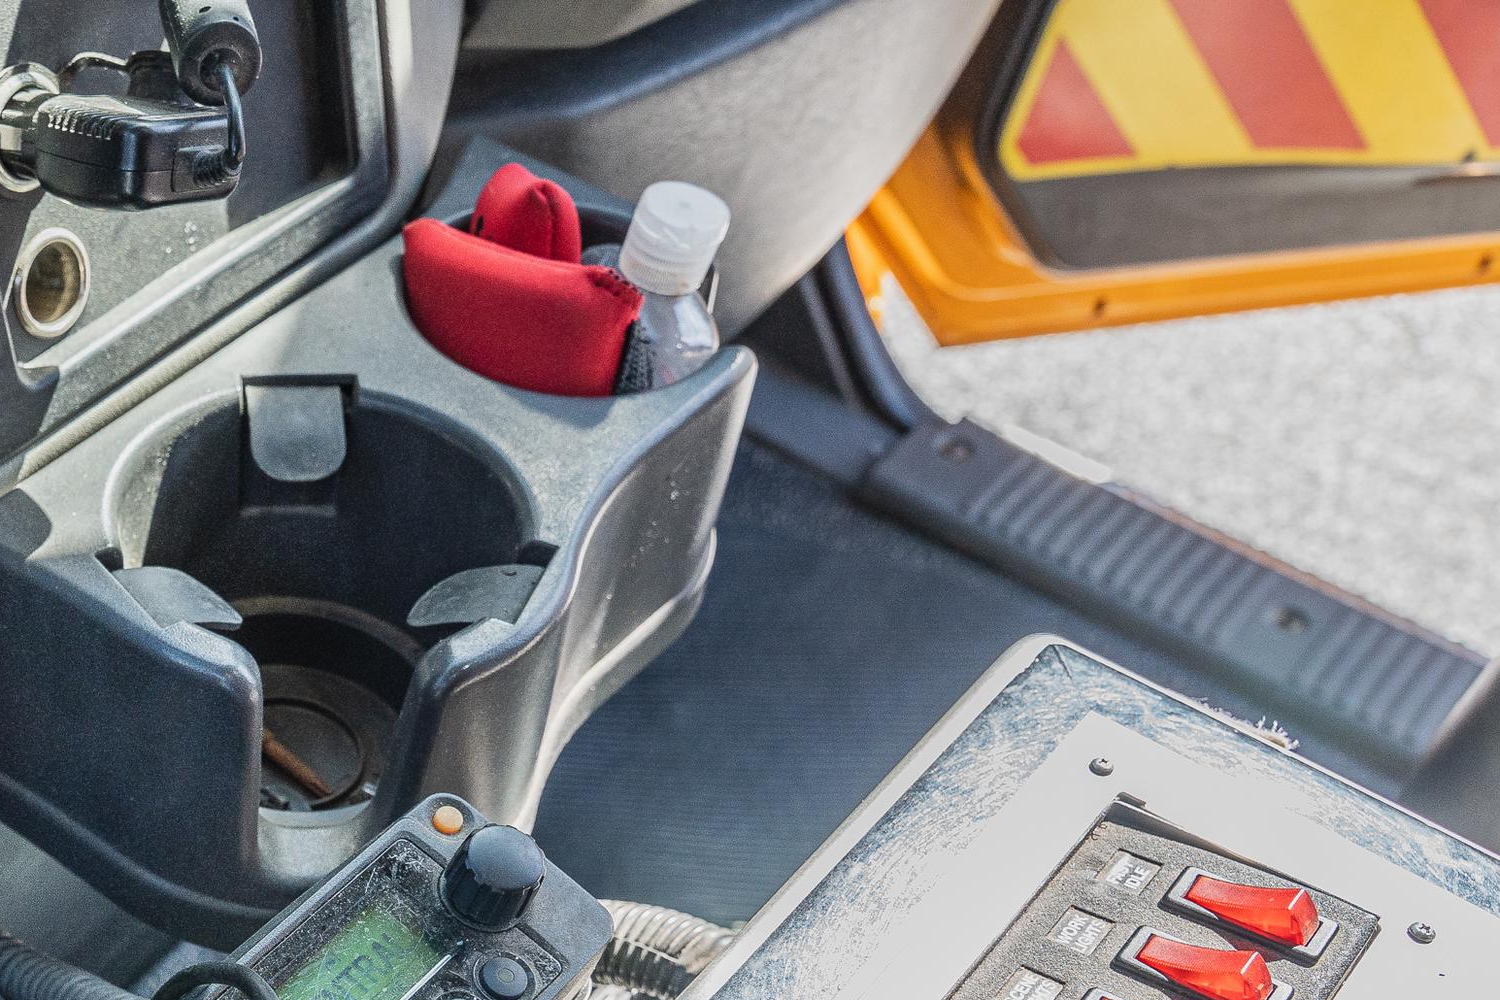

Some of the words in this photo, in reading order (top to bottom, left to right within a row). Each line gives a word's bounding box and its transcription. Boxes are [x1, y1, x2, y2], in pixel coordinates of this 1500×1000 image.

[1124, 864, 1147, 890] IDLE
[1056, 915, 1088, 945] WORK
[1071, 919, 1105, 954] LIGHTS
